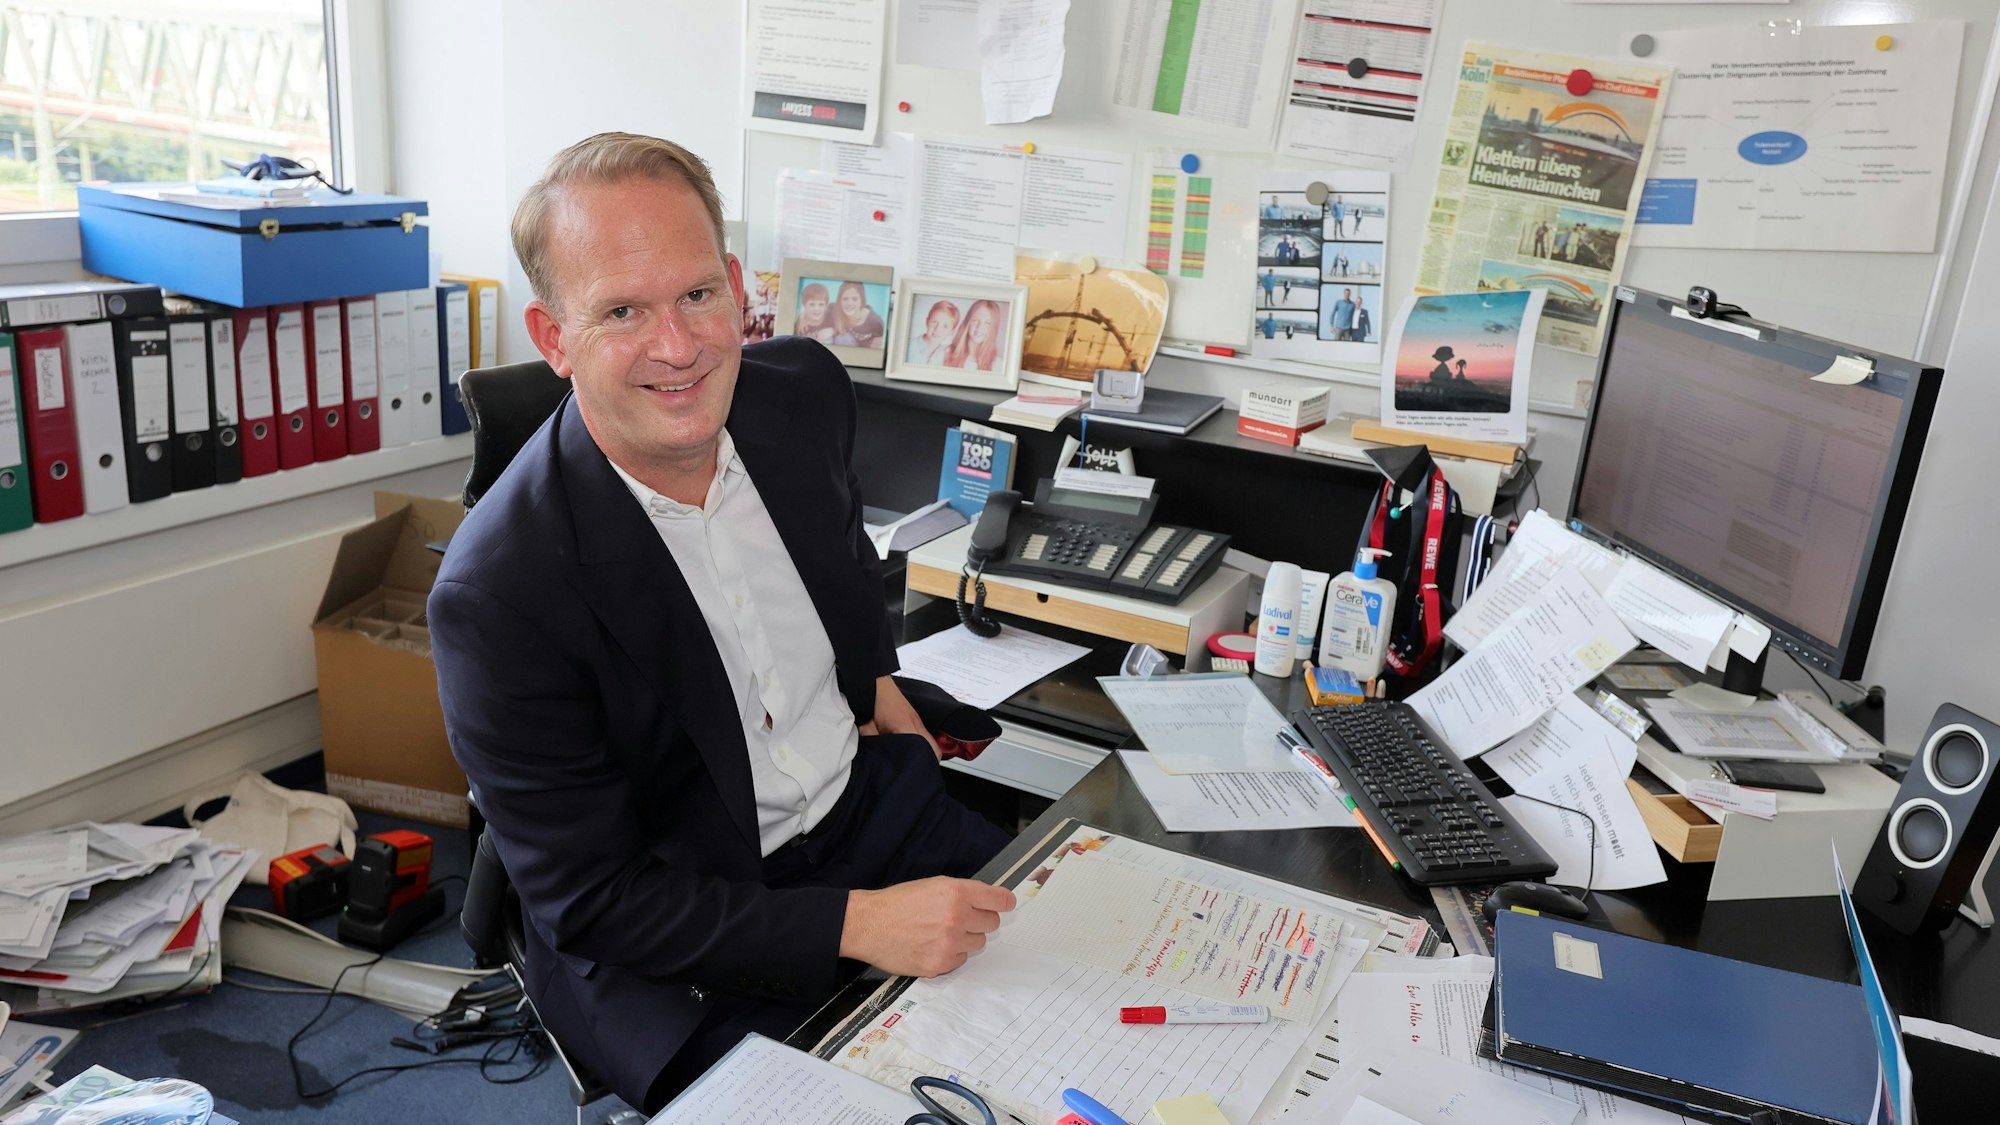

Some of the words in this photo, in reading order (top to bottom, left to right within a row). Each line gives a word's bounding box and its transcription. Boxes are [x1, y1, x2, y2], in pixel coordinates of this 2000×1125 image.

[1460, 65, 1491, 84] Köln!
[1476, 145, 1536, 171] Klettern
[1538, 155, 1582, 179] übers
[1471, 164, 1602, 203] Henkelmännchen
[960, 454, 991, 470] 500
[962, 441, 993, 459] TOP
[1432, 479, 1444, 511] REWE
[1424, 537, 1438, 570] REWE
[1263, 603, 1293, 621] Lodival
[1336, 589, 1379, 609] CeraVe
[1562, 773, 1582, 801] mich
[1577, 763, 1598, 794] Jeder
[1591, 792, 1614, 828] Bissen
